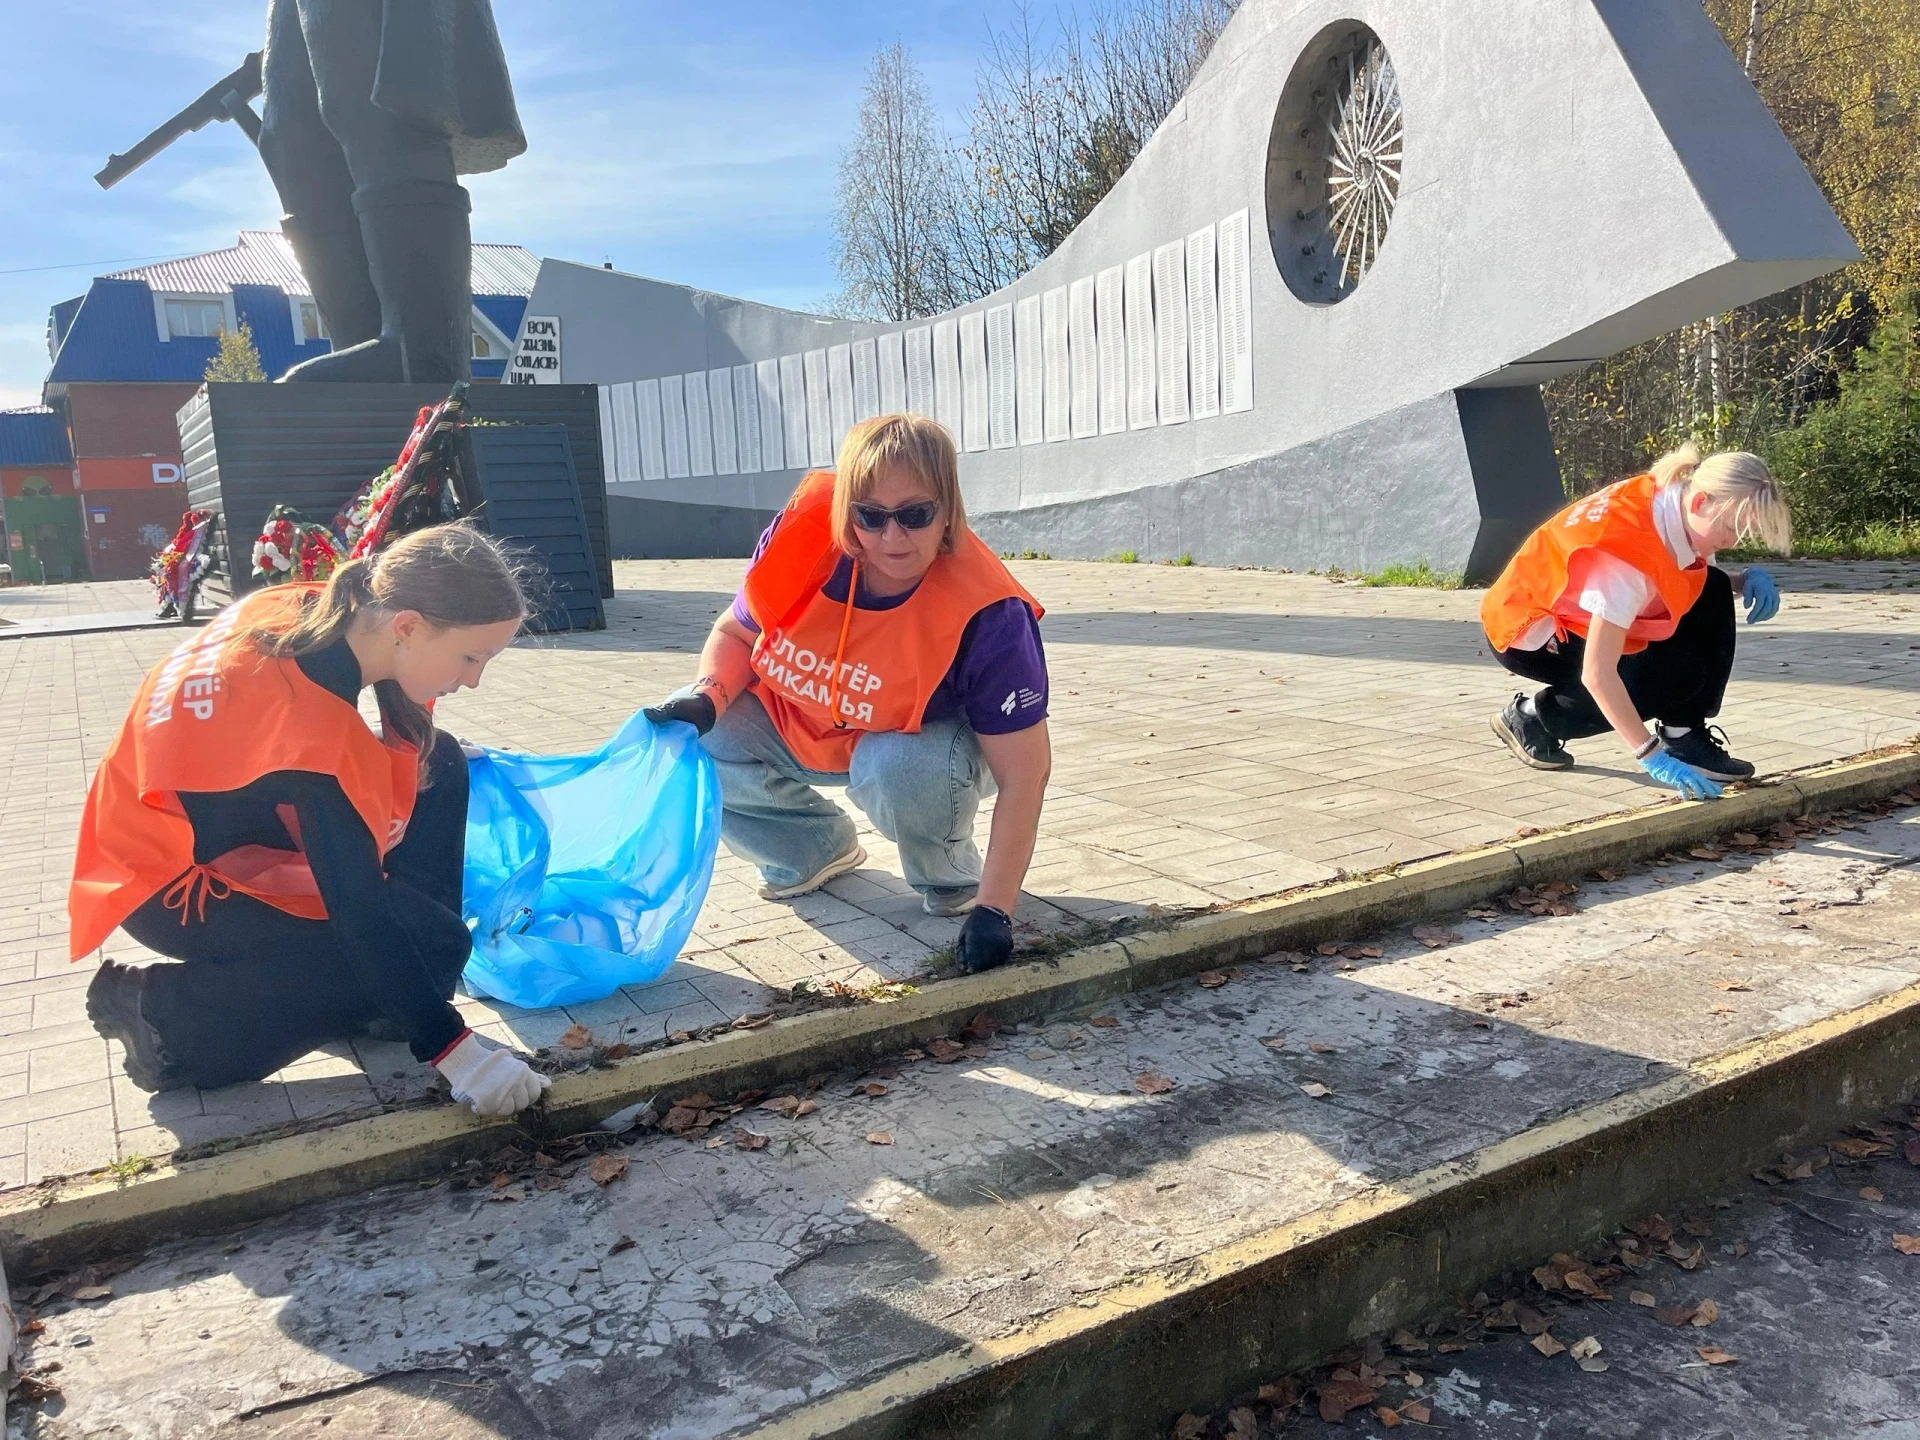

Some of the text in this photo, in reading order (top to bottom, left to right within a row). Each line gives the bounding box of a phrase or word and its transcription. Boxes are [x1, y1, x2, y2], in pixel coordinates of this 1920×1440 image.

[522, 338, 556, 352] ЖИЗНЬ
[152, 463, 186, 484] D
[769, 627, 882, 695] ОЛОНТЁР
[752, 648, 874, 723] РИКАМЬЯ
